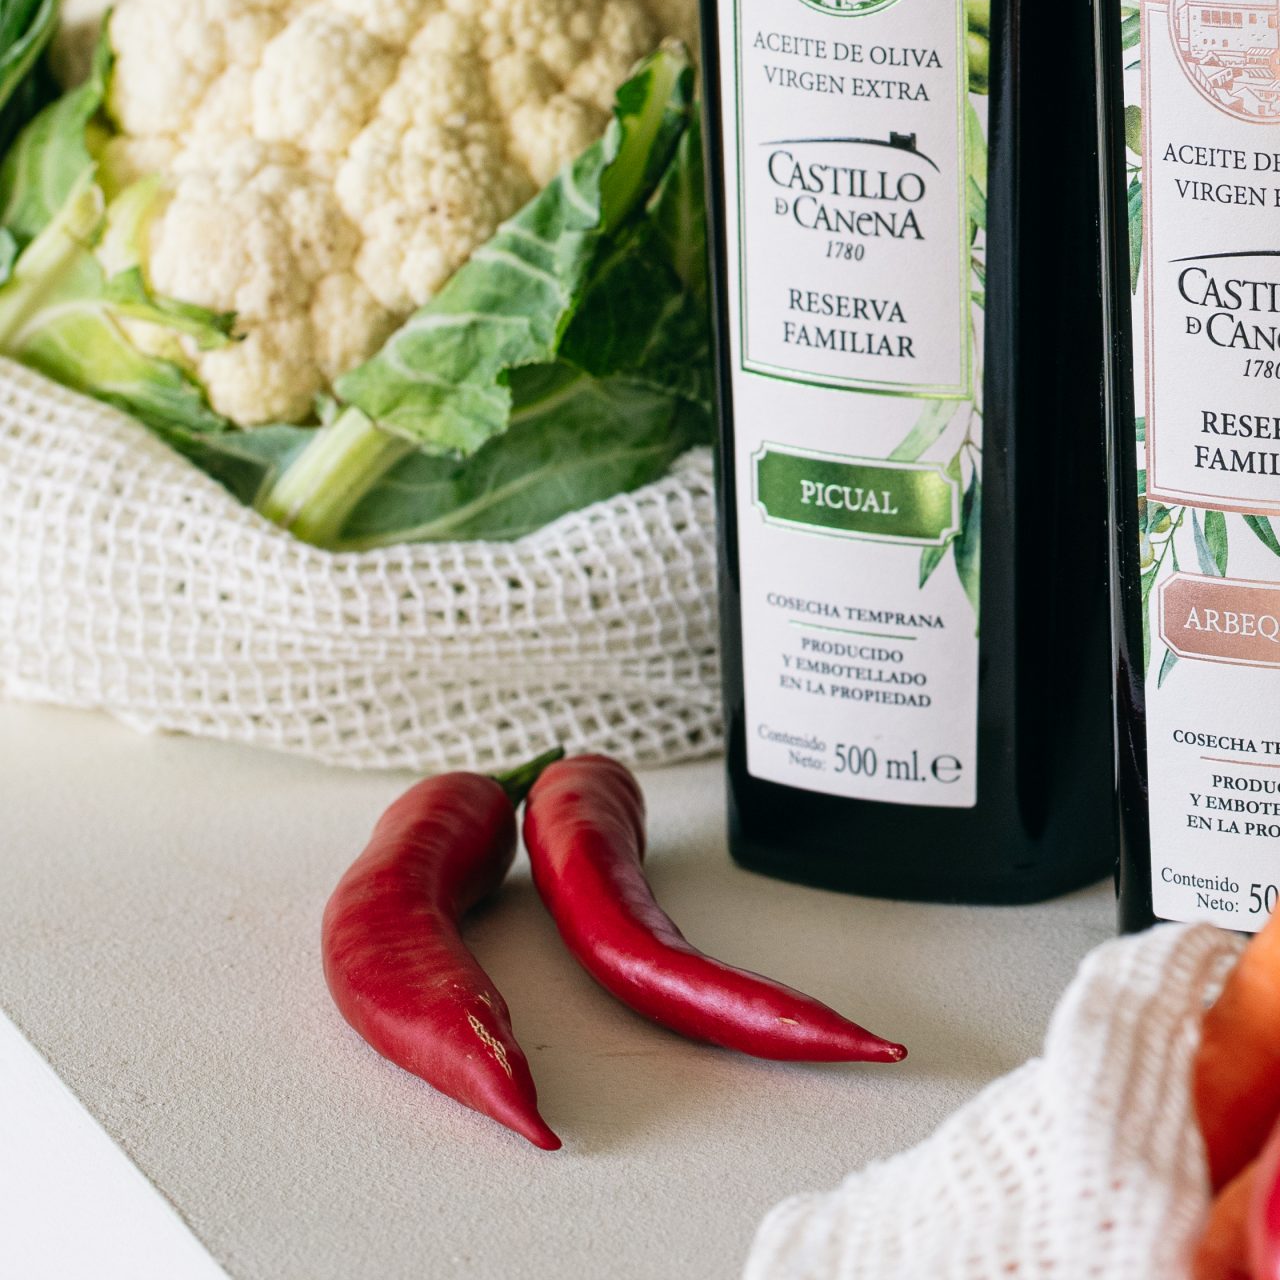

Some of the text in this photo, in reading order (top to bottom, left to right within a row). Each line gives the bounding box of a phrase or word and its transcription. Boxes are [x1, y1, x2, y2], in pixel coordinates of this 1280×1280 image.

[754, 31, 943, 69] ACEITE DE OLIVA
[763, 64, 930, 102] VIRGEN EXTRA
[1163, 143, 1247, 170] ACEITE
[768, 150, 925, 203] CASTILLO
[1173, 178, 1268, 207] VIRGEN
[826, 240, 865, 262] 1780
[788, 289, 907, 322] RESERVA
[782, 322, 916, 359] FAMILIAR
[800, 479, 898, 515] PICUAL
[766, 592, 945, 629] COSECHA TEMPRANA
[800, 637, 904, 662] PRODUCIDO
[782, 654, 928, 686] Y EMBOTELLADO
[779, 674, 932, 708] EN LA PROPIEDAD
[758, 724, 827, 752] Contenido
[1173, 730, 1256, 753] COSECHA
[833, 744, 878, 778] 500
[1190, 793, 1202, 807] Y
[1187, 814, 1213, 830] EN
[1217, 818, 1239, 835] LA
[1160, 866, 1240, 893] Contenido
